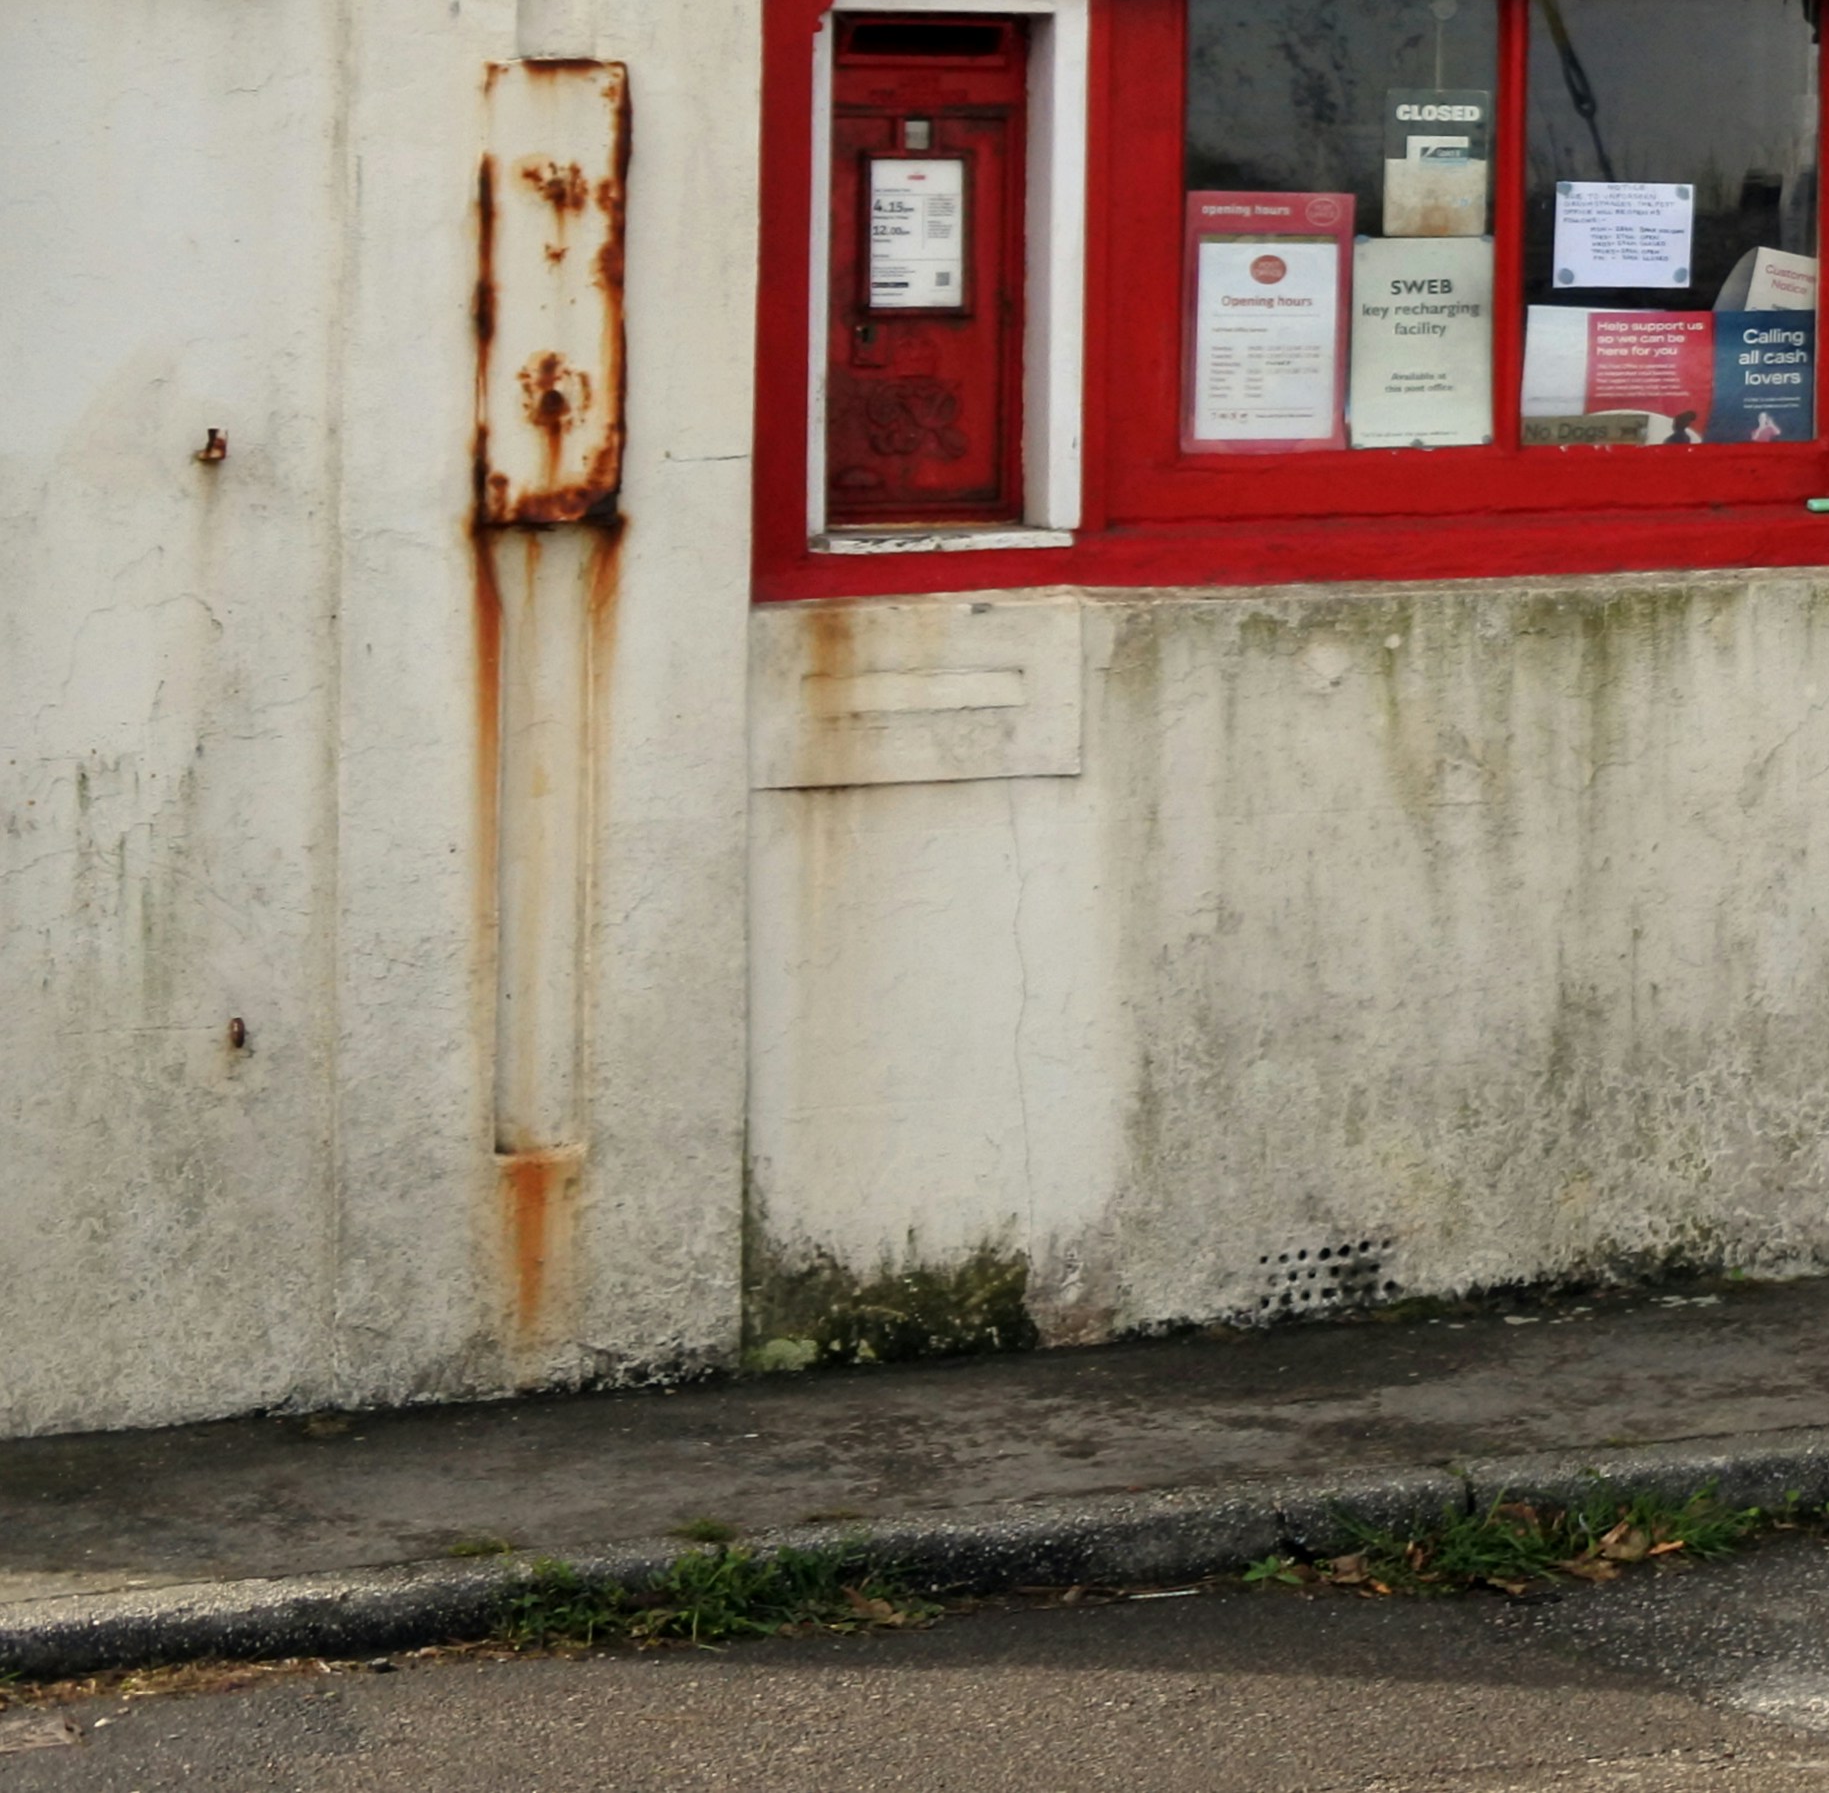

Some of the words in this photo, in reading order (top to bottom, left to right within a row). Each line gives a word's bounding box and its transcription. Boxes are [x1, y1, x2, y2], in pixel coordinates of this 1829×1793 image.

[1396, 104, 1480, 122] CLOSED
[1201, 204, 1252, 217] opening
[1254, 205, 1291, 216] hours
[1391, 278, 1453, 295] SWEB
[1770, 279, 1808, 296] Notice
[1221, 295, 1274, 308] Opening
[1277, 296, 1313, 307] hours
[1362, 303, 1389, 321] key
[1394, 301, 1481, 318] recharging
[1394, 322, 1447, 338] facility
[1596, 321, 1629, 333] Help
[1631, 321, 1684, 333] support
[1686, 321, 1705, 331] us
[1596, 335, 1614, 344] so
[1617, 335, 1637, 344] we
[1639, 335, 1665, 344] can
[1667, 333, 1686, 344] be
[1742, 328, 1805, 347] Calling
[1596, 346, 1629, 356] here
[1631, 346, 1650, 356] for
[1653, 346, 1678, 358] you
[1738, 351, 1759, 366] all
[1762, 349, 1808, 365] cash
[1391, 372, 1435, 381] Available
[1744, 370, 1802, 386] lovers
[1524, 421, 1551, 440] No
[1558, 423, 1607, 443] Dogs
